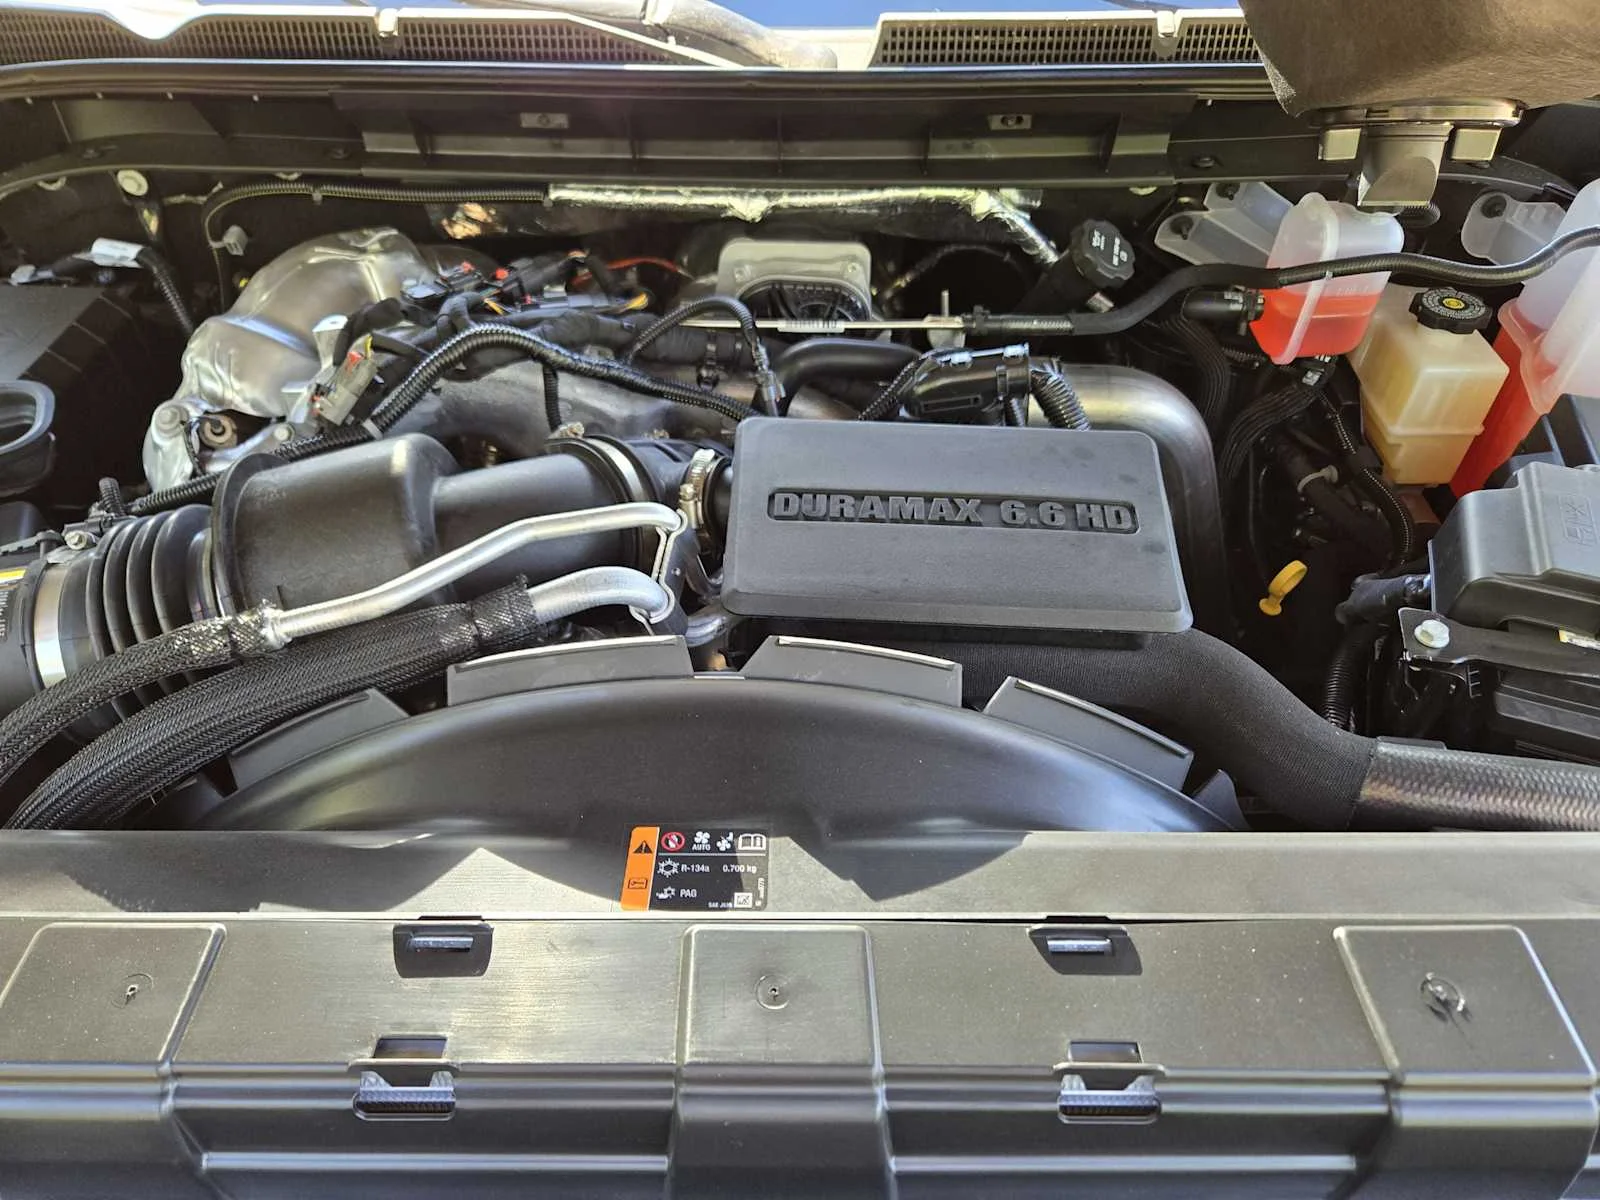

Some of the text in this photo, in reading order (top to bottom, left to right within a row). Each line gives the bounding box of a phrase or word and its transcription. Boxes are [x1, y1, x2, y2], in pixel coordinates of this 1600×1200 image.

[773, 491, 1135, 533] DURAMAX 6.6 HD
[692, 843, 711, 851] AUTO
[681, 863, 757, 874] R-134a 0.700 kg
[680, 889, 698, 898] PAG
